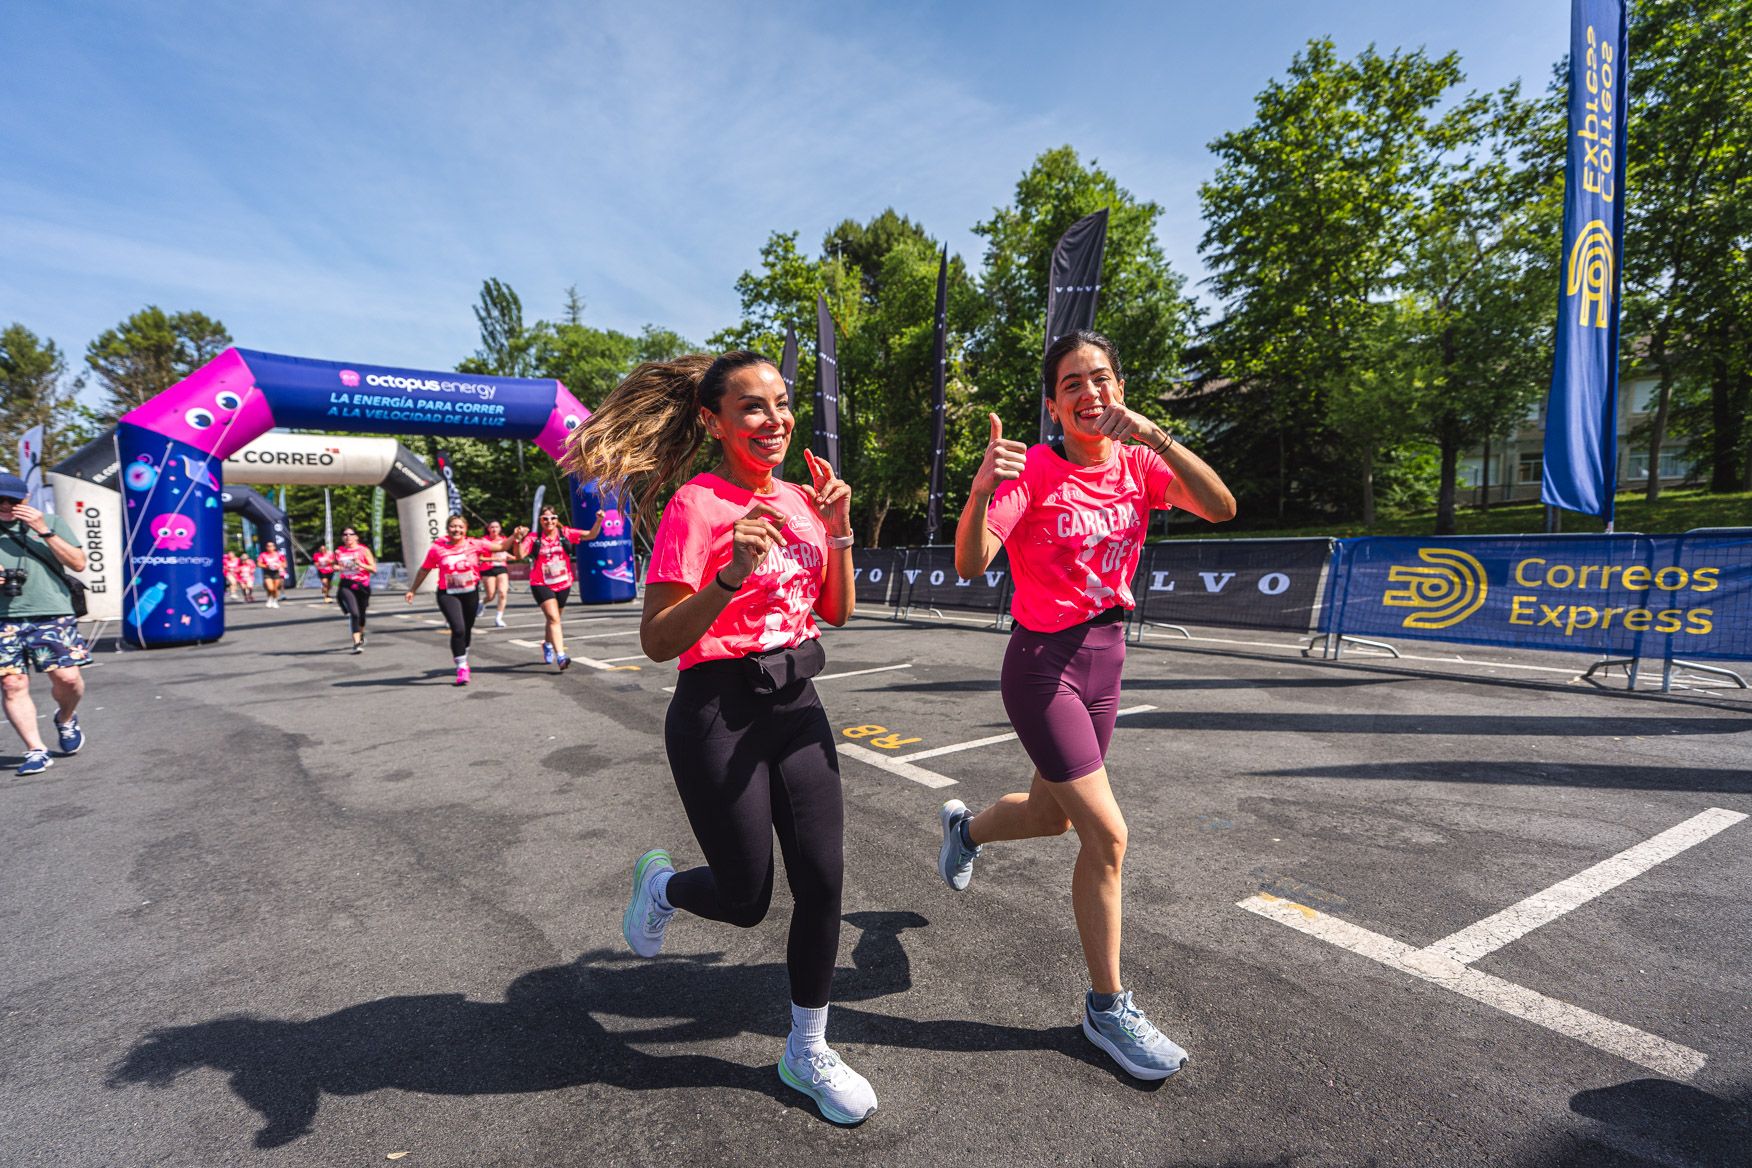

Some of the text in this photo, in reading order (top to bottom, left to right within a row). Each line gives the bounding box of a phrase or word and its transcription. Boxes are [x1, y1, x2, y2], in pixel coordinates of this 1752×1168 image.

[330, 392, 505, 415] LA ENERGÍA PARA CORRER
[327, 406, 507, 427] A LA VELOCIDAD DE LA LUZ
[244, 450, 334, 466] CORREO
[426, 502, 436, 517] EL
[85, 507, 107, 594] EL CORREO
[1149, 571, 1291, 596] LVO
[1514, 557, 1720, 592] Correos
[1509, 595, 1715, 636] Express
